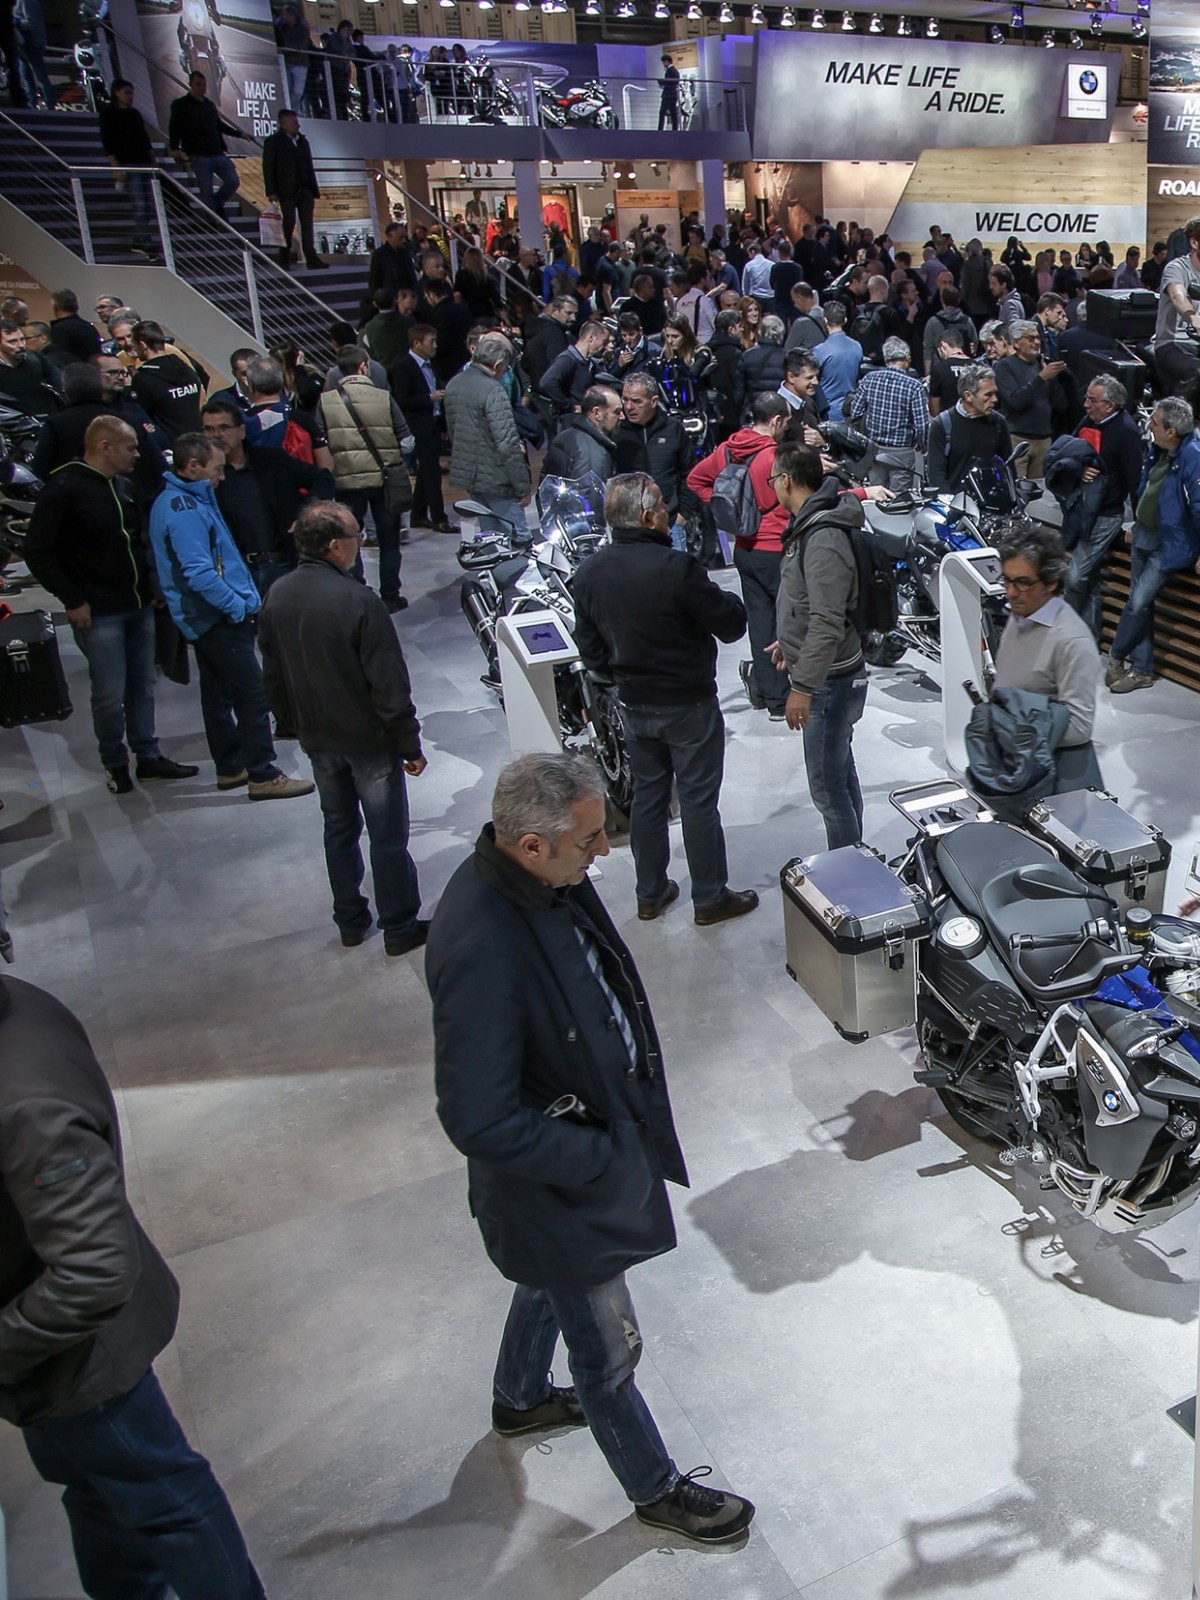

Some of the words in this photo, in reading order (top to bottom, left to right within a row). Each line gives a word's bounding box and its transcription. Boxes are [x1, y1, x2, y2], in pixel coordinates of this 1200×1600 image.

[825, 61, 902, 86] MAKE
[907, 65, 960, 89] LIFE
[245, 81, 276, 100] MAKE
[237, 99, 260, 118] LIFE
[262, 101, 270, 119] A
[924, 90, 941, 112] A
[948, 91, 1005, 115] RIDE.
[975, 212, 1099, 233] WELCOME
[169, 384, 198, 399] TEAM
